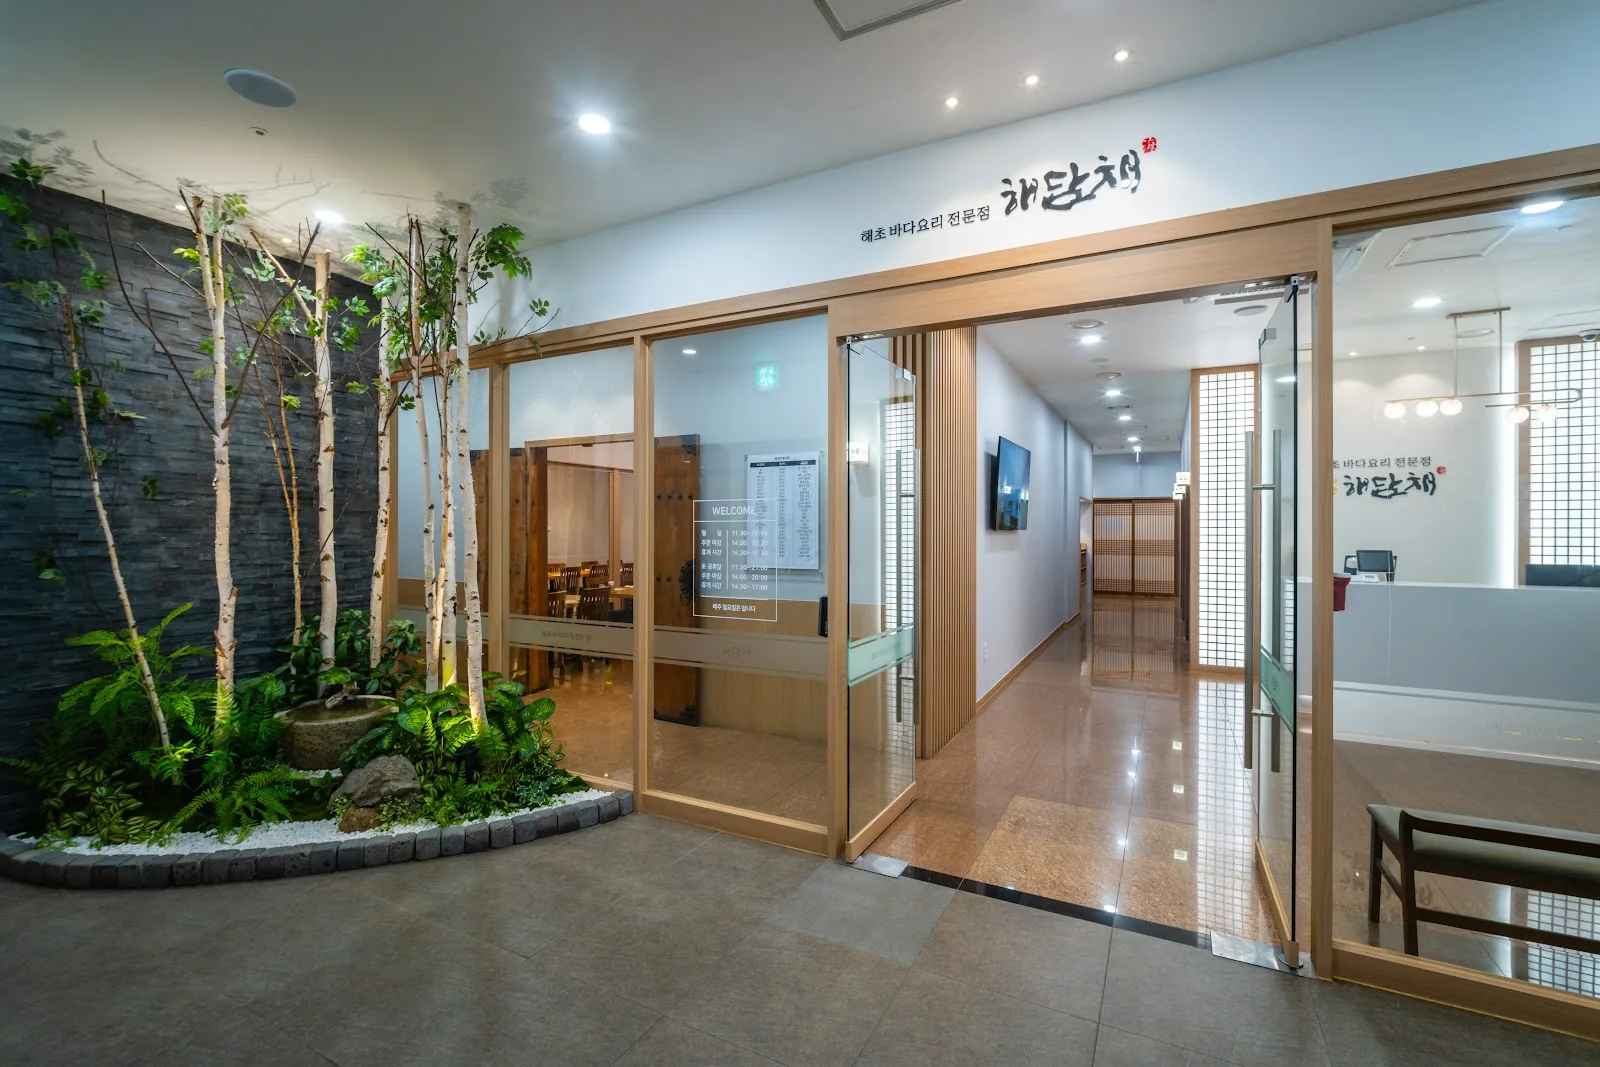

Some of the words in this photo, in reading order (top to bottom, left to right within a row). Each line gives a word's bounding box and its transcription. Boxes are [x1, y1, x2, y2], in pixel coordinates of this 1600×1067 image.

[860, 226, 887, 244] 해초
[888, 214, 943, 238] 바다요리
[946, 205, 991, 227] 전문점
[1343, 457, 1391, 469] 바다요리
[1394, 456, 1431, 468] 전문점
[712, 506, 757, 516] WELCOME
